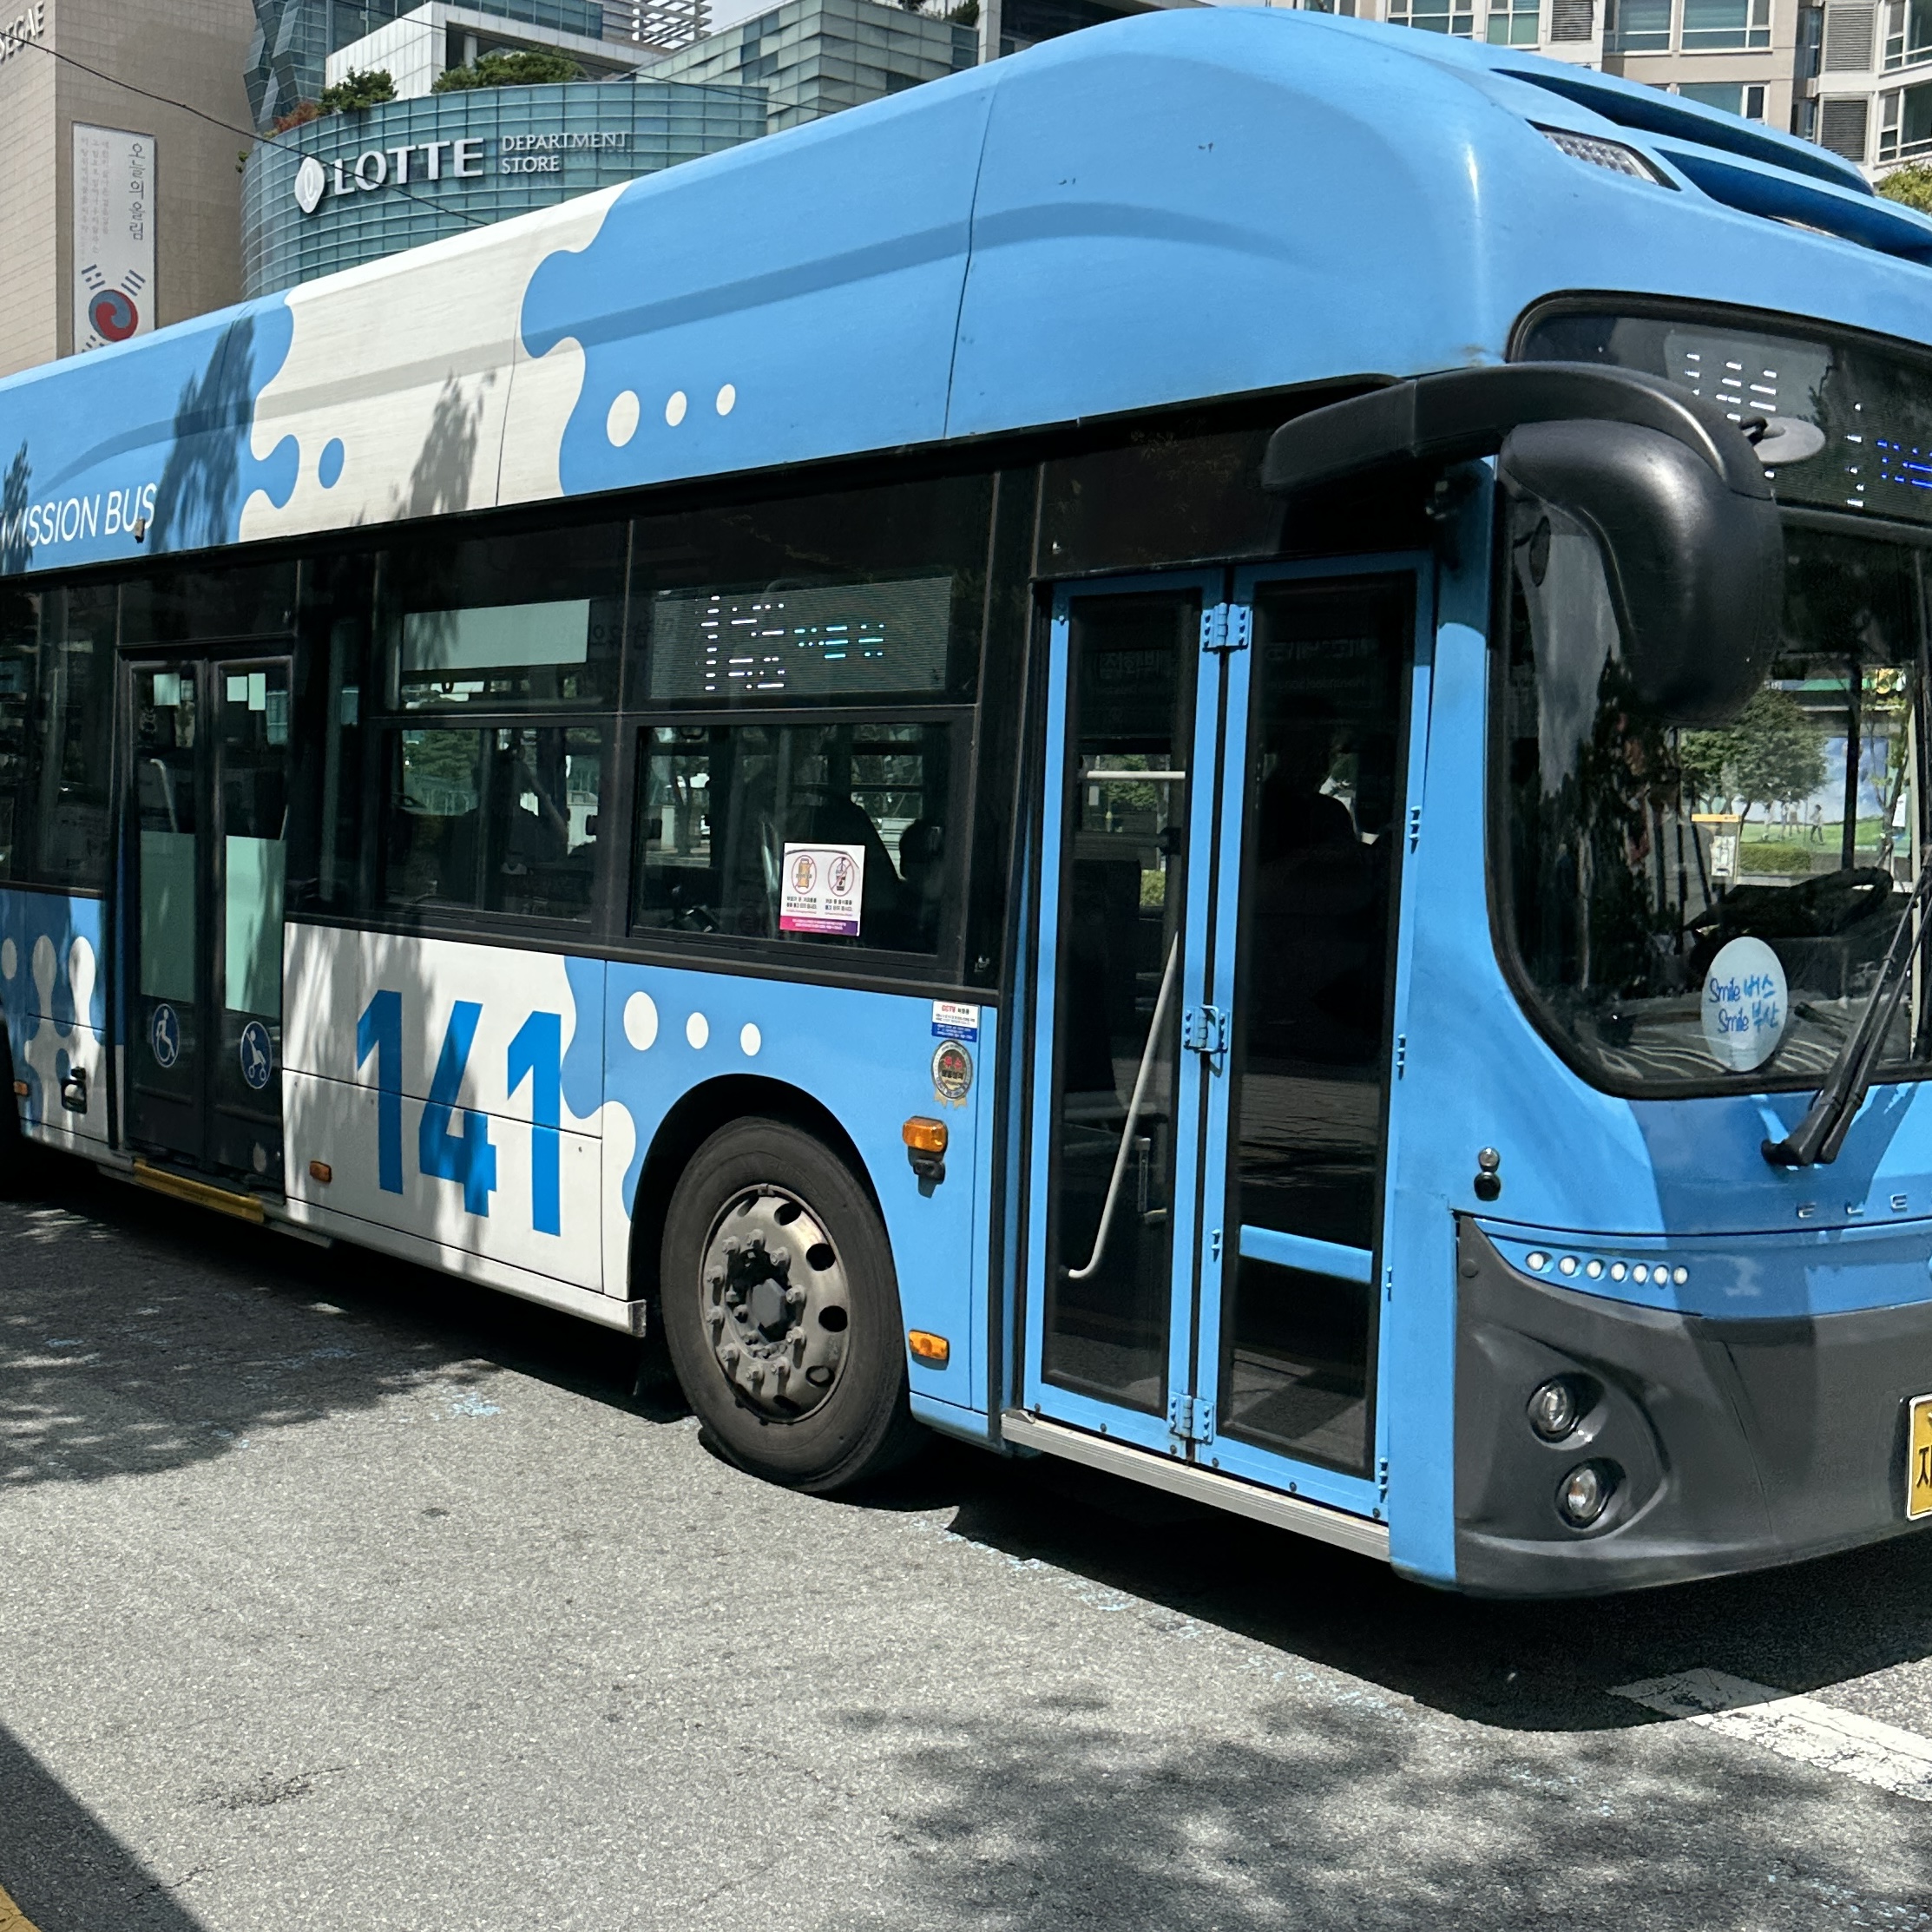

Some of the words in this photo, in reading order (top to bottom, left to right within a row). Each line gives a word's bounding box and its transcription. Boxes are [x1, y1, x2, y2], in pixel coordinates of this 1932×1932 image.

[501, 131, 628, 152] DEPARTMENT
[334, 137, 484, 195] LOTTE
[501, 155, 561, 174] STORE
[0, 494, 101, 550] MISSION
[104, 483, 158, 536] BUS
[1709, 977, 1741, 1002] Smile
[1743, 973, 1776, 999] 버스
[1718, 1007, 1750, 1033] Smile
[1751, 1000, 1782, 1033] 부산
[357, 989, 562, 1238] 141
